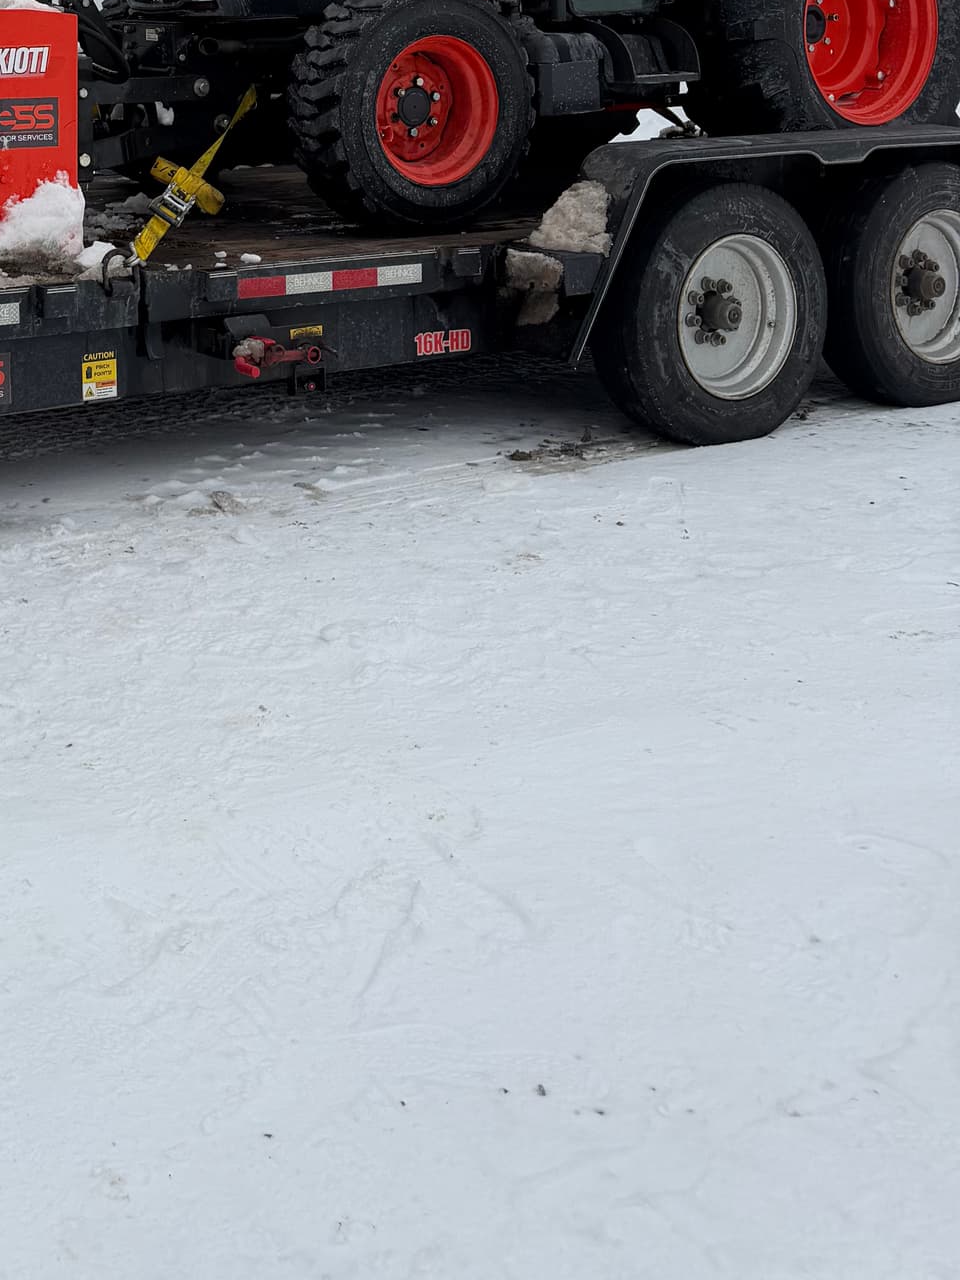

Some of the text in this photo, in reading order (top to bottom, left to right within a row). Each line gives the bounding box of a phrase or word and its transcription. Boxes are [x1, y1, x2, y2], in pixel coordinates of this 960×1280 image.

[17, 133, 54, 142] SERVICES
[385, 268, 415, 280] BEHNKE
[294, 275, 325, 288] BEHNKE
[414, 328, 471, 357] 16K-HD
[83, 351, 114, 360] CAUTION
